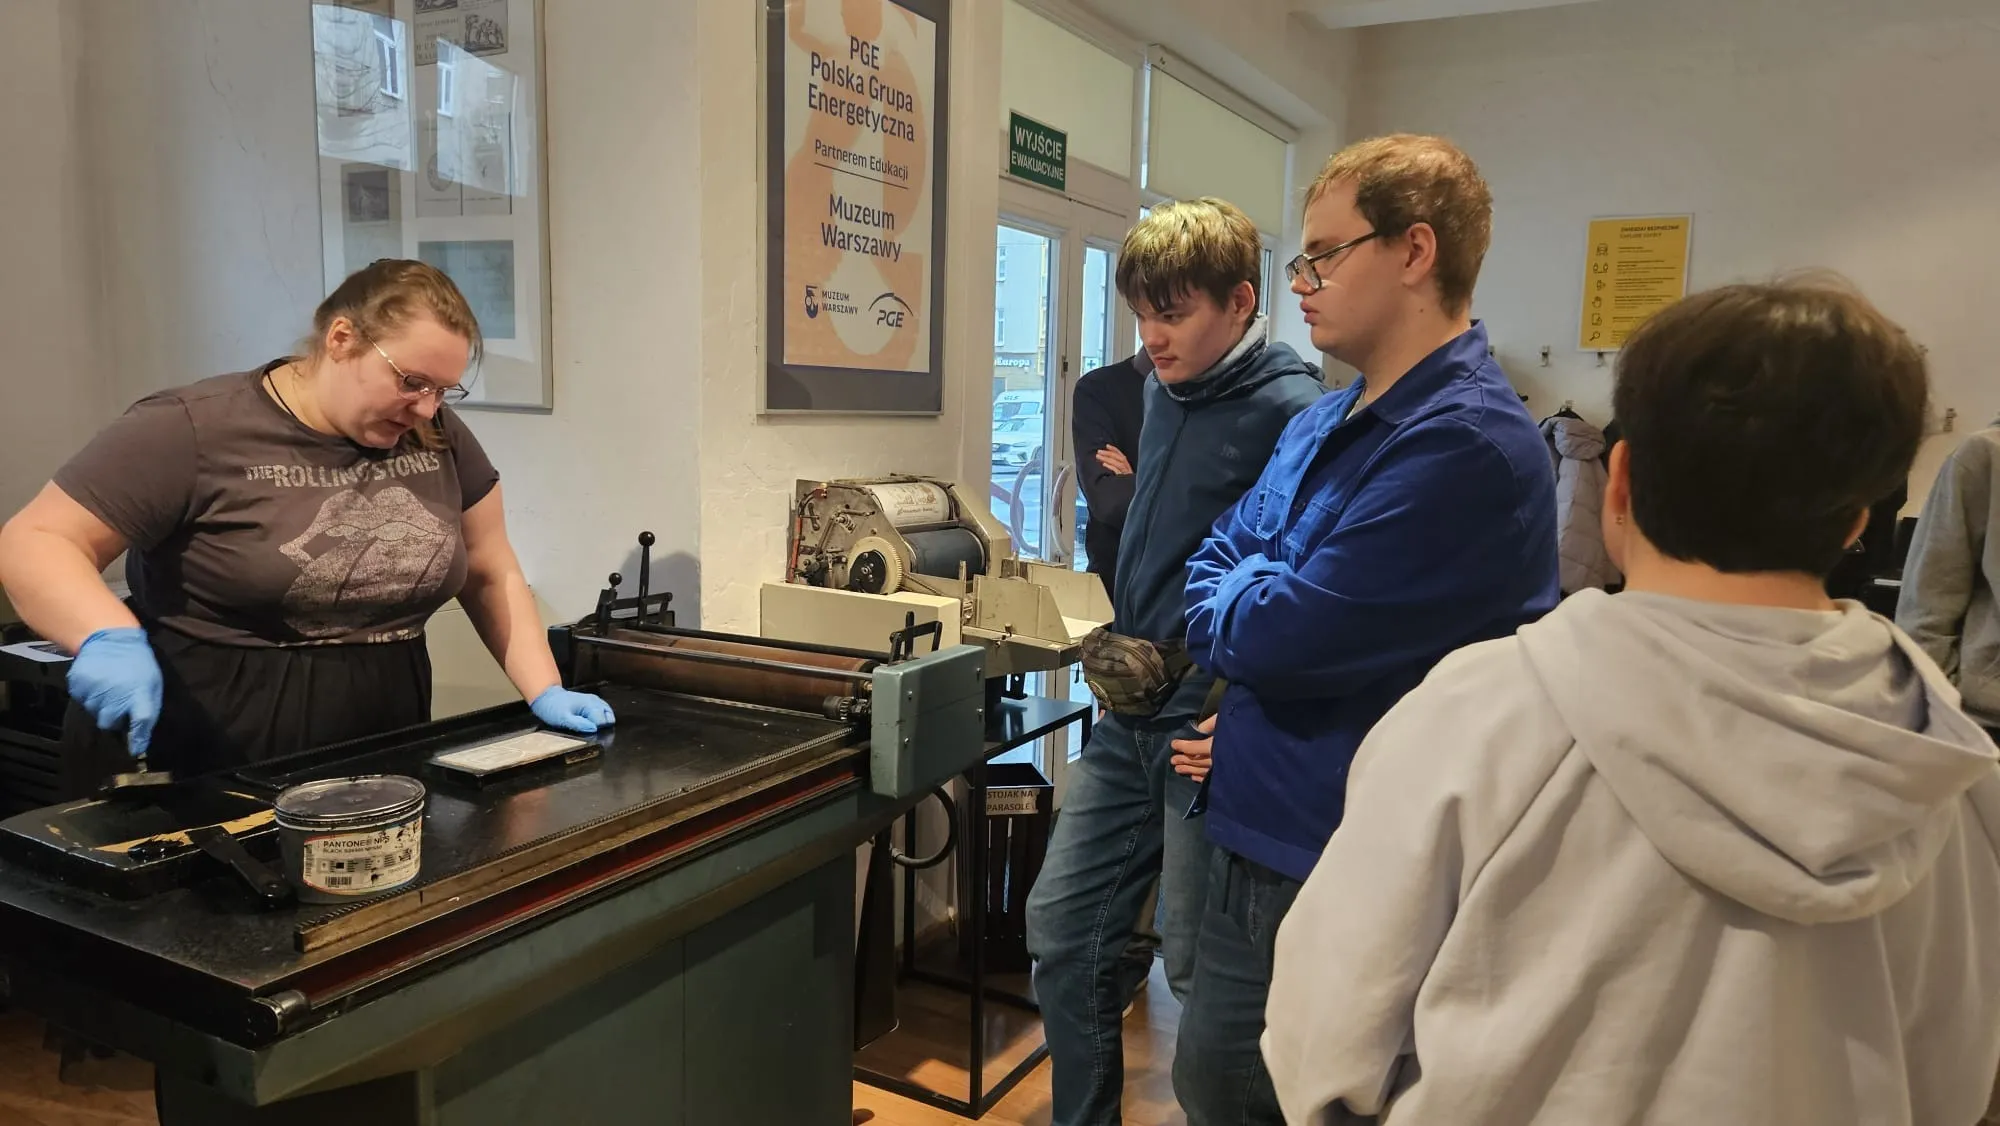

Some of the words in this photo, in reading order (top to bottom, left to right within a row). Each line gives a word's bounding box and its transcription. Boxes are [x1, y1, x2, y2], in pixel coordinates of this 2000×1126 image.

[850, 35, 880, 71] PGE
[811, 52, 865, 95] Polska
[868, 75, 914, 113] Grupa
[808, 83, 915, 142] Energetyczna
[1015, 125, 1063, 160] WYJŚCIE
[815, 139, 867, 168] Partnerem
[869, 155, 909, 181] Edukacji
[1011, 150, 1064, 181] EWAKUACYJNE
[829, 194, 895, 230] Muzeum
[821, 222, 901, 262] Warszawy
[822, 290, 850, 301] MUZEUM
[822, 302, 858, 315] WARSZAWY
[877, 309, 904, 328] PGE
[244, 465, 273, 480] THE
[372, 451, 440, 480] STONES
[987, 790, 1019, 799] STOJAK
[1021, 790, 1033, 798] NA
[987, 802, 1030, 812] PARASOLE
